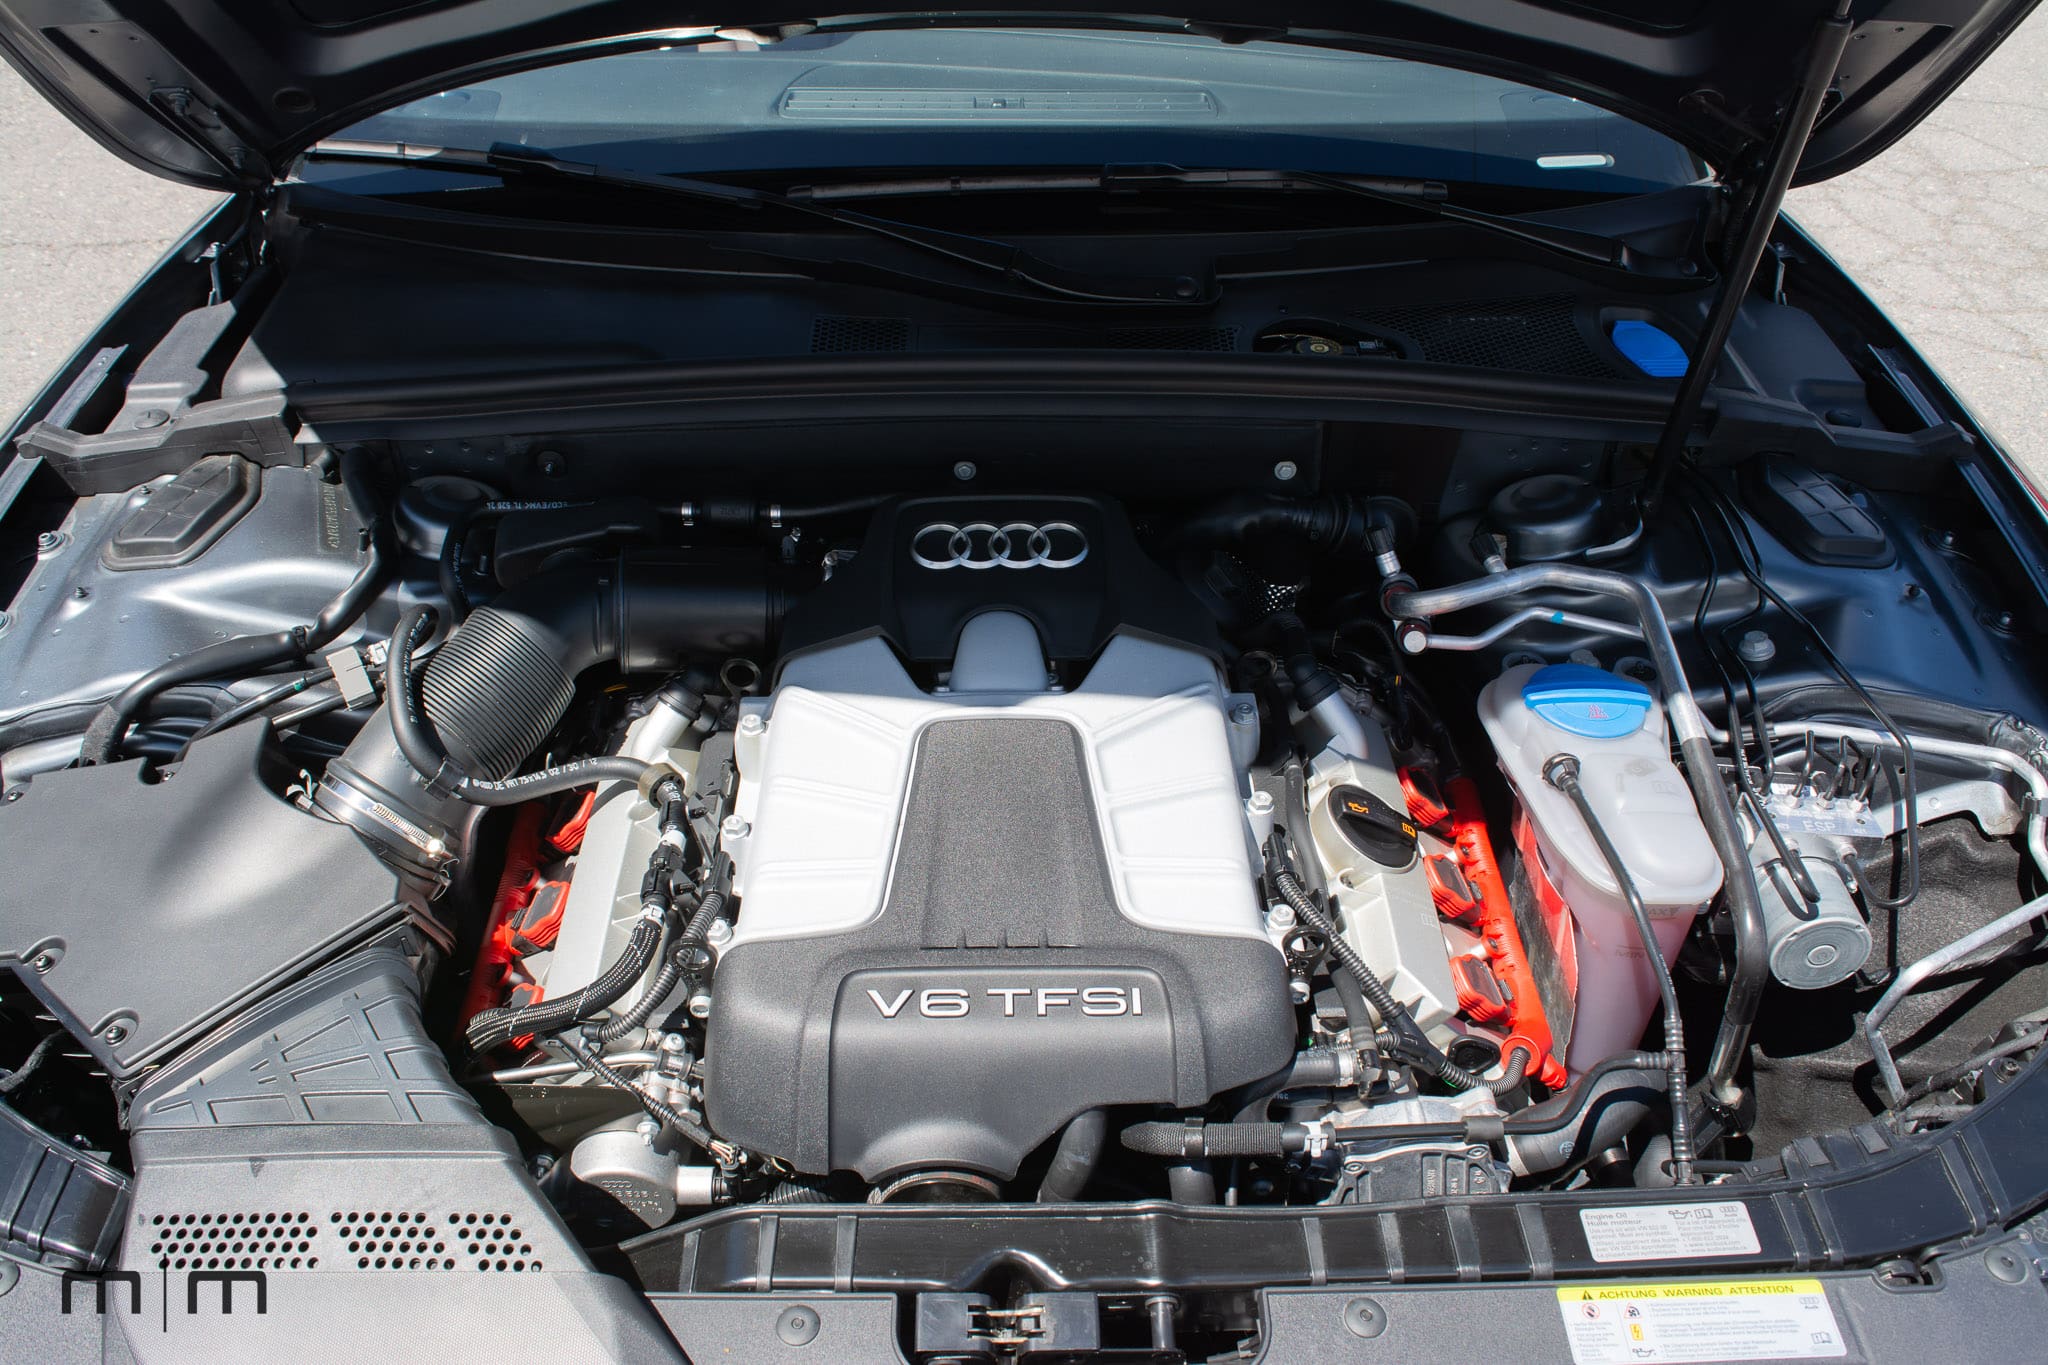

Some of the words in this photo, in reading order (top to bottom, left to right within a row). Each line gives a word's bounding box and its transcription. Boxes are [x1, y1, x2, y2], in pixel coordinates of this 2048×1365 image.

[1802, 819, 1836, 833] ESP
[866, 988, 970, 1018] V6
[987, 987, 1143, 1017] TFSI
[1584, 1212, 1614, 1220] Engine
[1599, 1289, 1657, 1300] ACHTUNG
[1663, 1287, 1723, 1298] WARNING
[1730, 1285, 1795, 1295] ATTENTION
